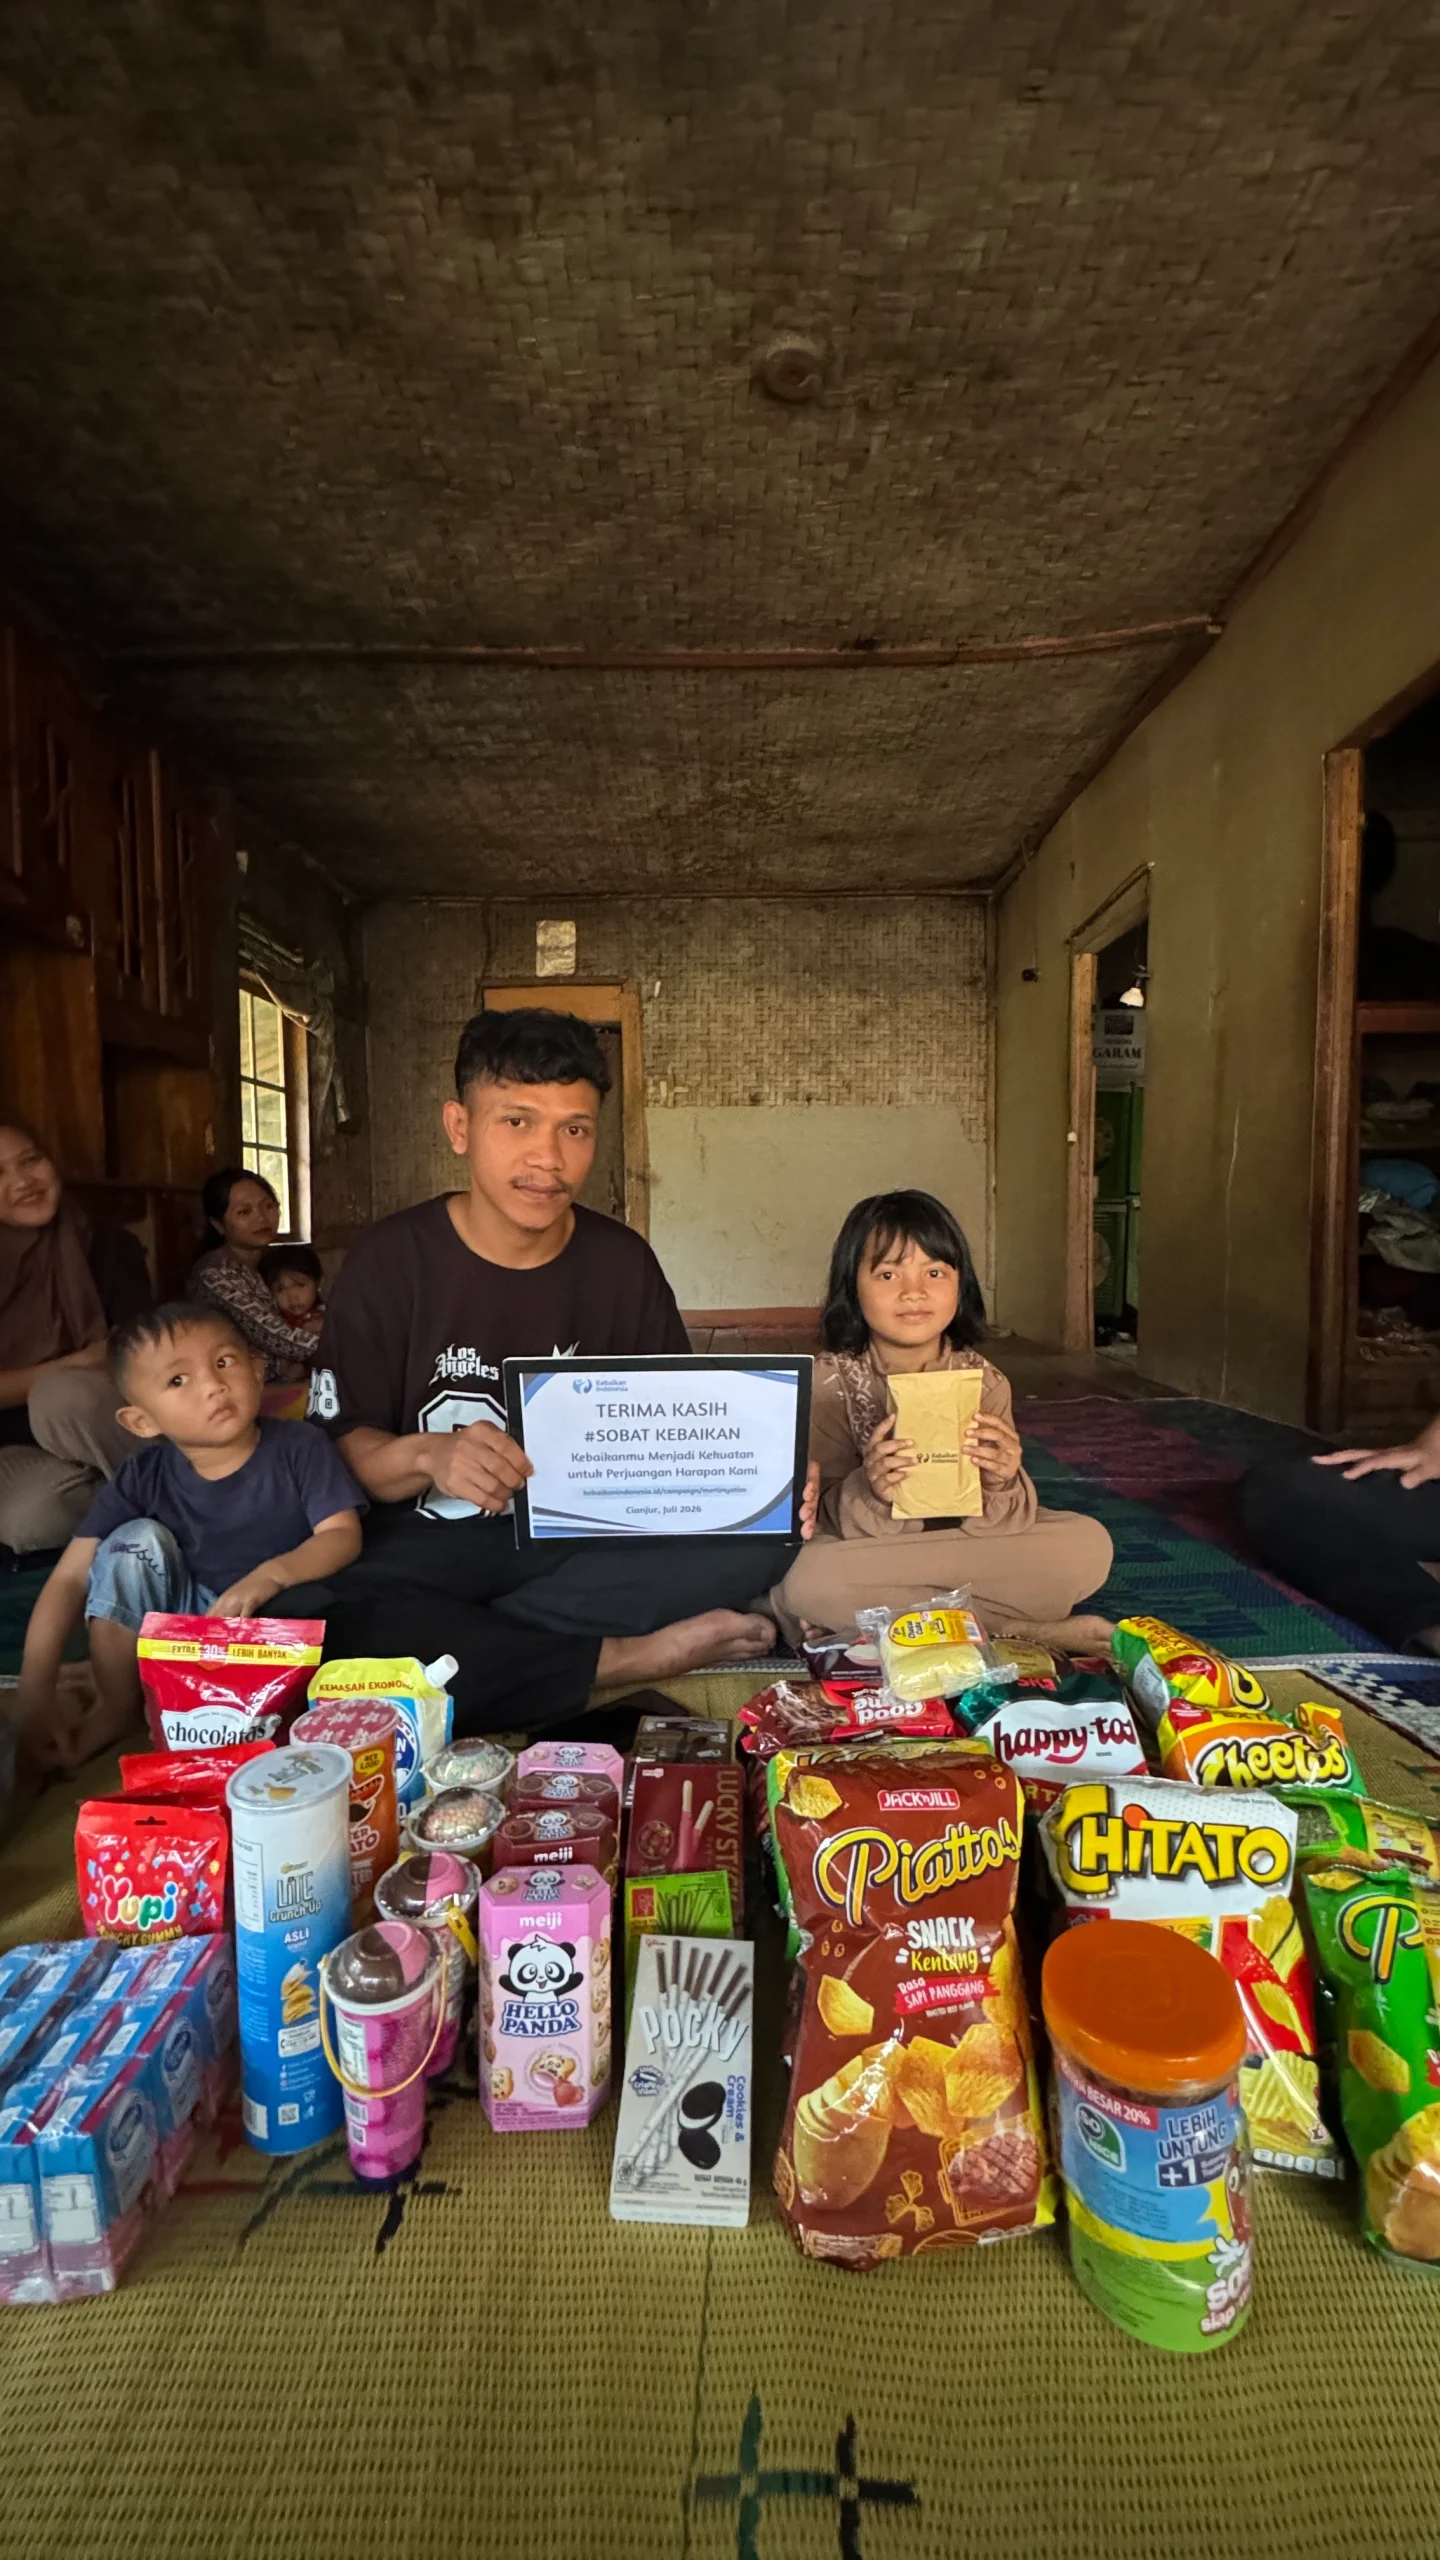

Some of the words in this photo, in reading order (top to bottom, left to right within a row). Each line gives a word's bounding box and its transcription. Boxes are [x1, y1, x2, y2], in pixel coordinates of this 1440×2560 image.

[447, 1343, 477, 1362] Los
[428, 1352, 500, 1387] Angeles
[596, 1402, 666, 1418] TERIMA
[672, 1401, 727, 1417] KASIH
[584, 1428, 650, 1443] #SOBAT
[655, 1427, 740, 1442] KEBAIKAN
[571, 1451, 645, 1463] Kebaikanmu
[648, 1450, 695, 1464] Menjadi
[698, 1449, 754, 1460] Kekuatan
[568, 1469, 603, 1479] untuk
[606, 1468, 672, 1480] Perjuangan
[675, 1467, 726, 1479] Harapan
[728, 1465, 758, 1476] Kami
[625, 1505, 661, 1515] Cianjur,
[663, 1505, 678, 1515] Juli
[172, 1645, 196, 1654] EXTRA
[232, 1649, 254, 1658] LEBIH
[257, 1650, 287, 1660] BANYAK
[319, 1681, 365, 1691] KEMASAN
[857, 1700, 924, 1725] Good
[993, 1720, 1088, 1764] happy
[715, 1769, 739, 1837] LUCKY
[534, 1846, 573, 1863] meiji
[812, 1817, 1021, 1928] Piattos
[101, 1874, 179, 1932] Yupi
[269, 1903, 306, 1924] Crunch
[308, 1900, 322, 1916] Up
[519, 1911, 562, 1930] meiji
[907, 1916, 975, 1948] SNACK
[140, 1923, 183, 1945] GUMMY
[284, 1927, 310, 1944] ASLI
[911, 1949, 979, 1972] Kentang
[904, 1991, 927, 2010] SAPI
[929, 1980, 985, 2000] PANGGANG
[505, 2002, 577, 2019] HELLO
[503, 2018, 579, 2035] PANDA
[726, 2074, 737, 2119] Cream
[735, 2075, 747, 2130] Cookies
[1087, 2087, 1121, 2114] BESAR
[1123, 2106, 1151, 2126] 20%
[1159, 2121, 1227, 2160] UNTUNG
[1161, 2159, 1197, 2185] +1
